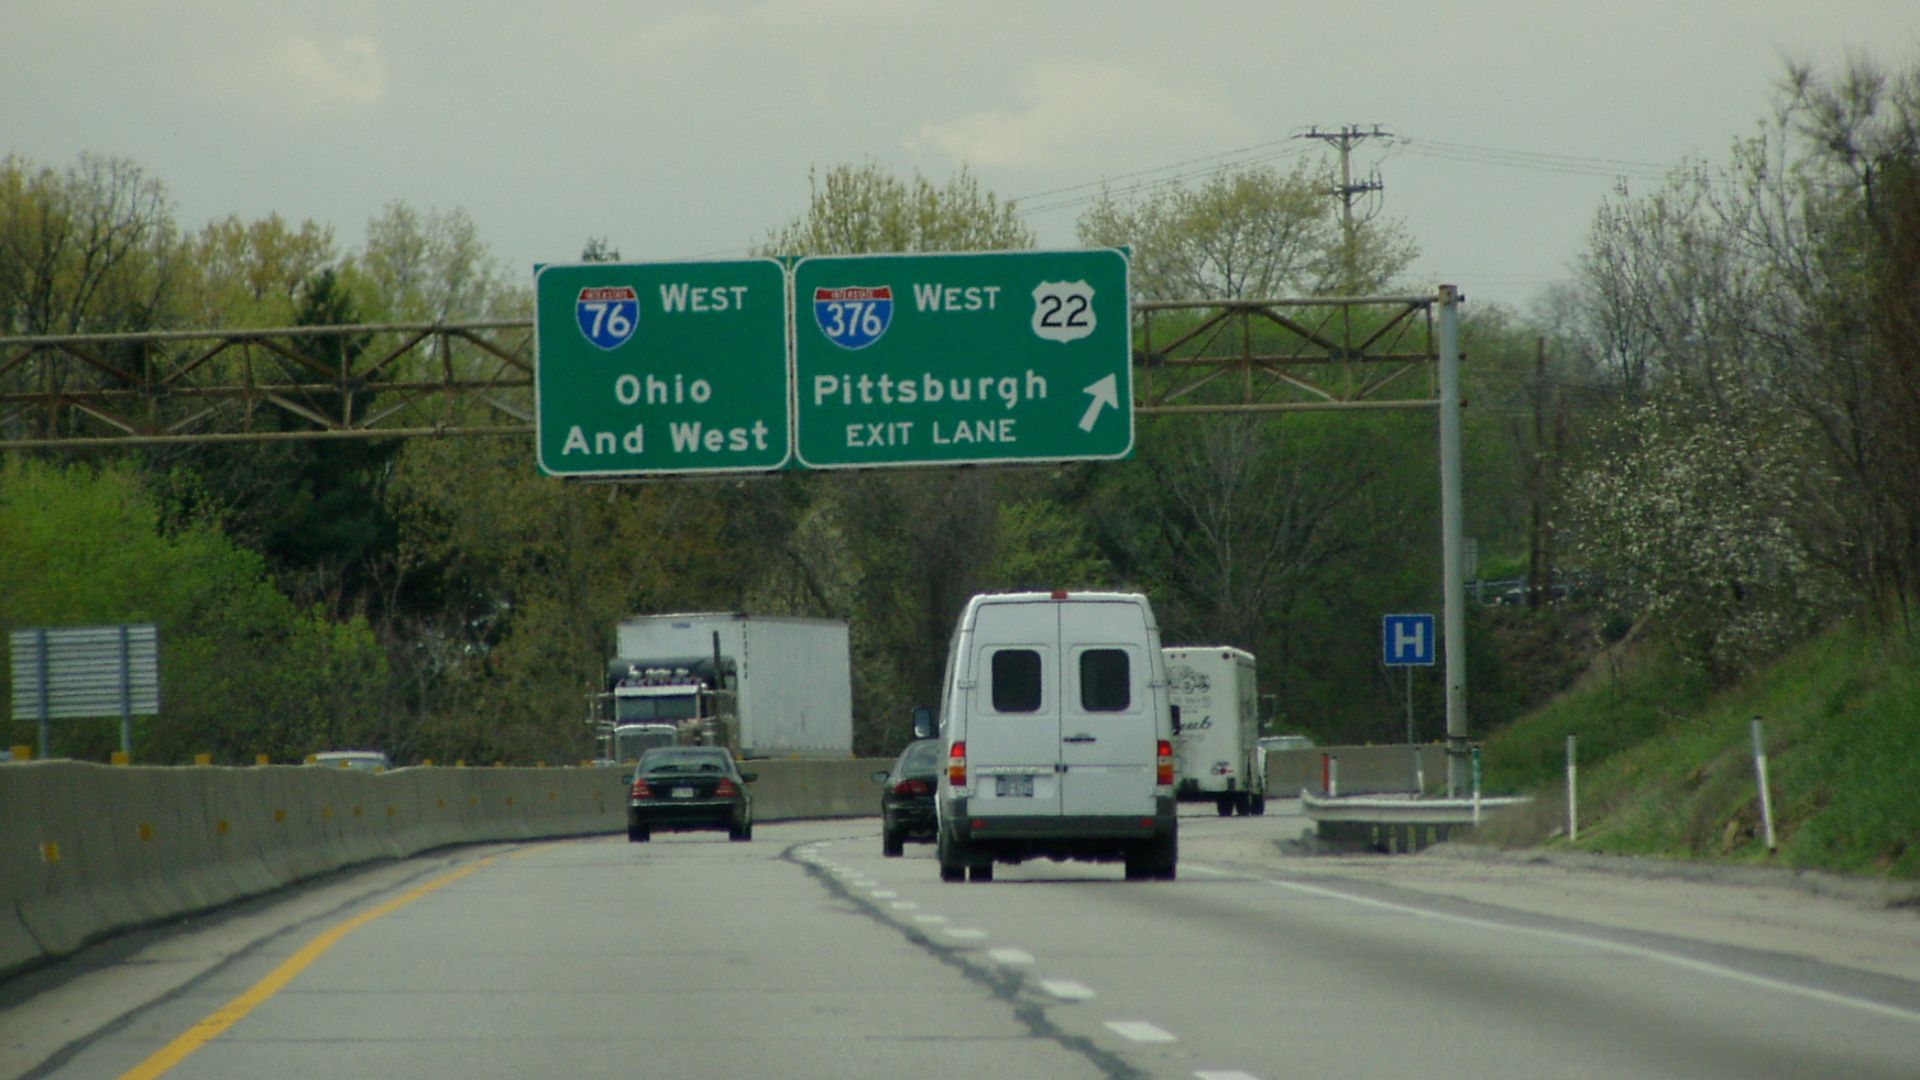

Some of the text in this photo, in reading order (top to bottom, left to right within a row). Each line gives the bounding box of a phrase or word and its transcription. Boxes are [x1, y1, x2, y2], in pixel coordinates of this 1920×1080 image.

[660, 283, 747, 313] WEST
[914, 283, 1000, 312] WEST
[1040, 295, 1087, 328] 22
[584, 303, 632, 338] 76
[825, 302, 883, 338] 376
[615, 374, 712, 405] Ohio
[814, 370, 1048, 410] Pittsburgh
[562, 420, 768, 456] And West
[846, 419, 1017, 447] EXIT LANE
[1395, 622, 1424, 658] H
